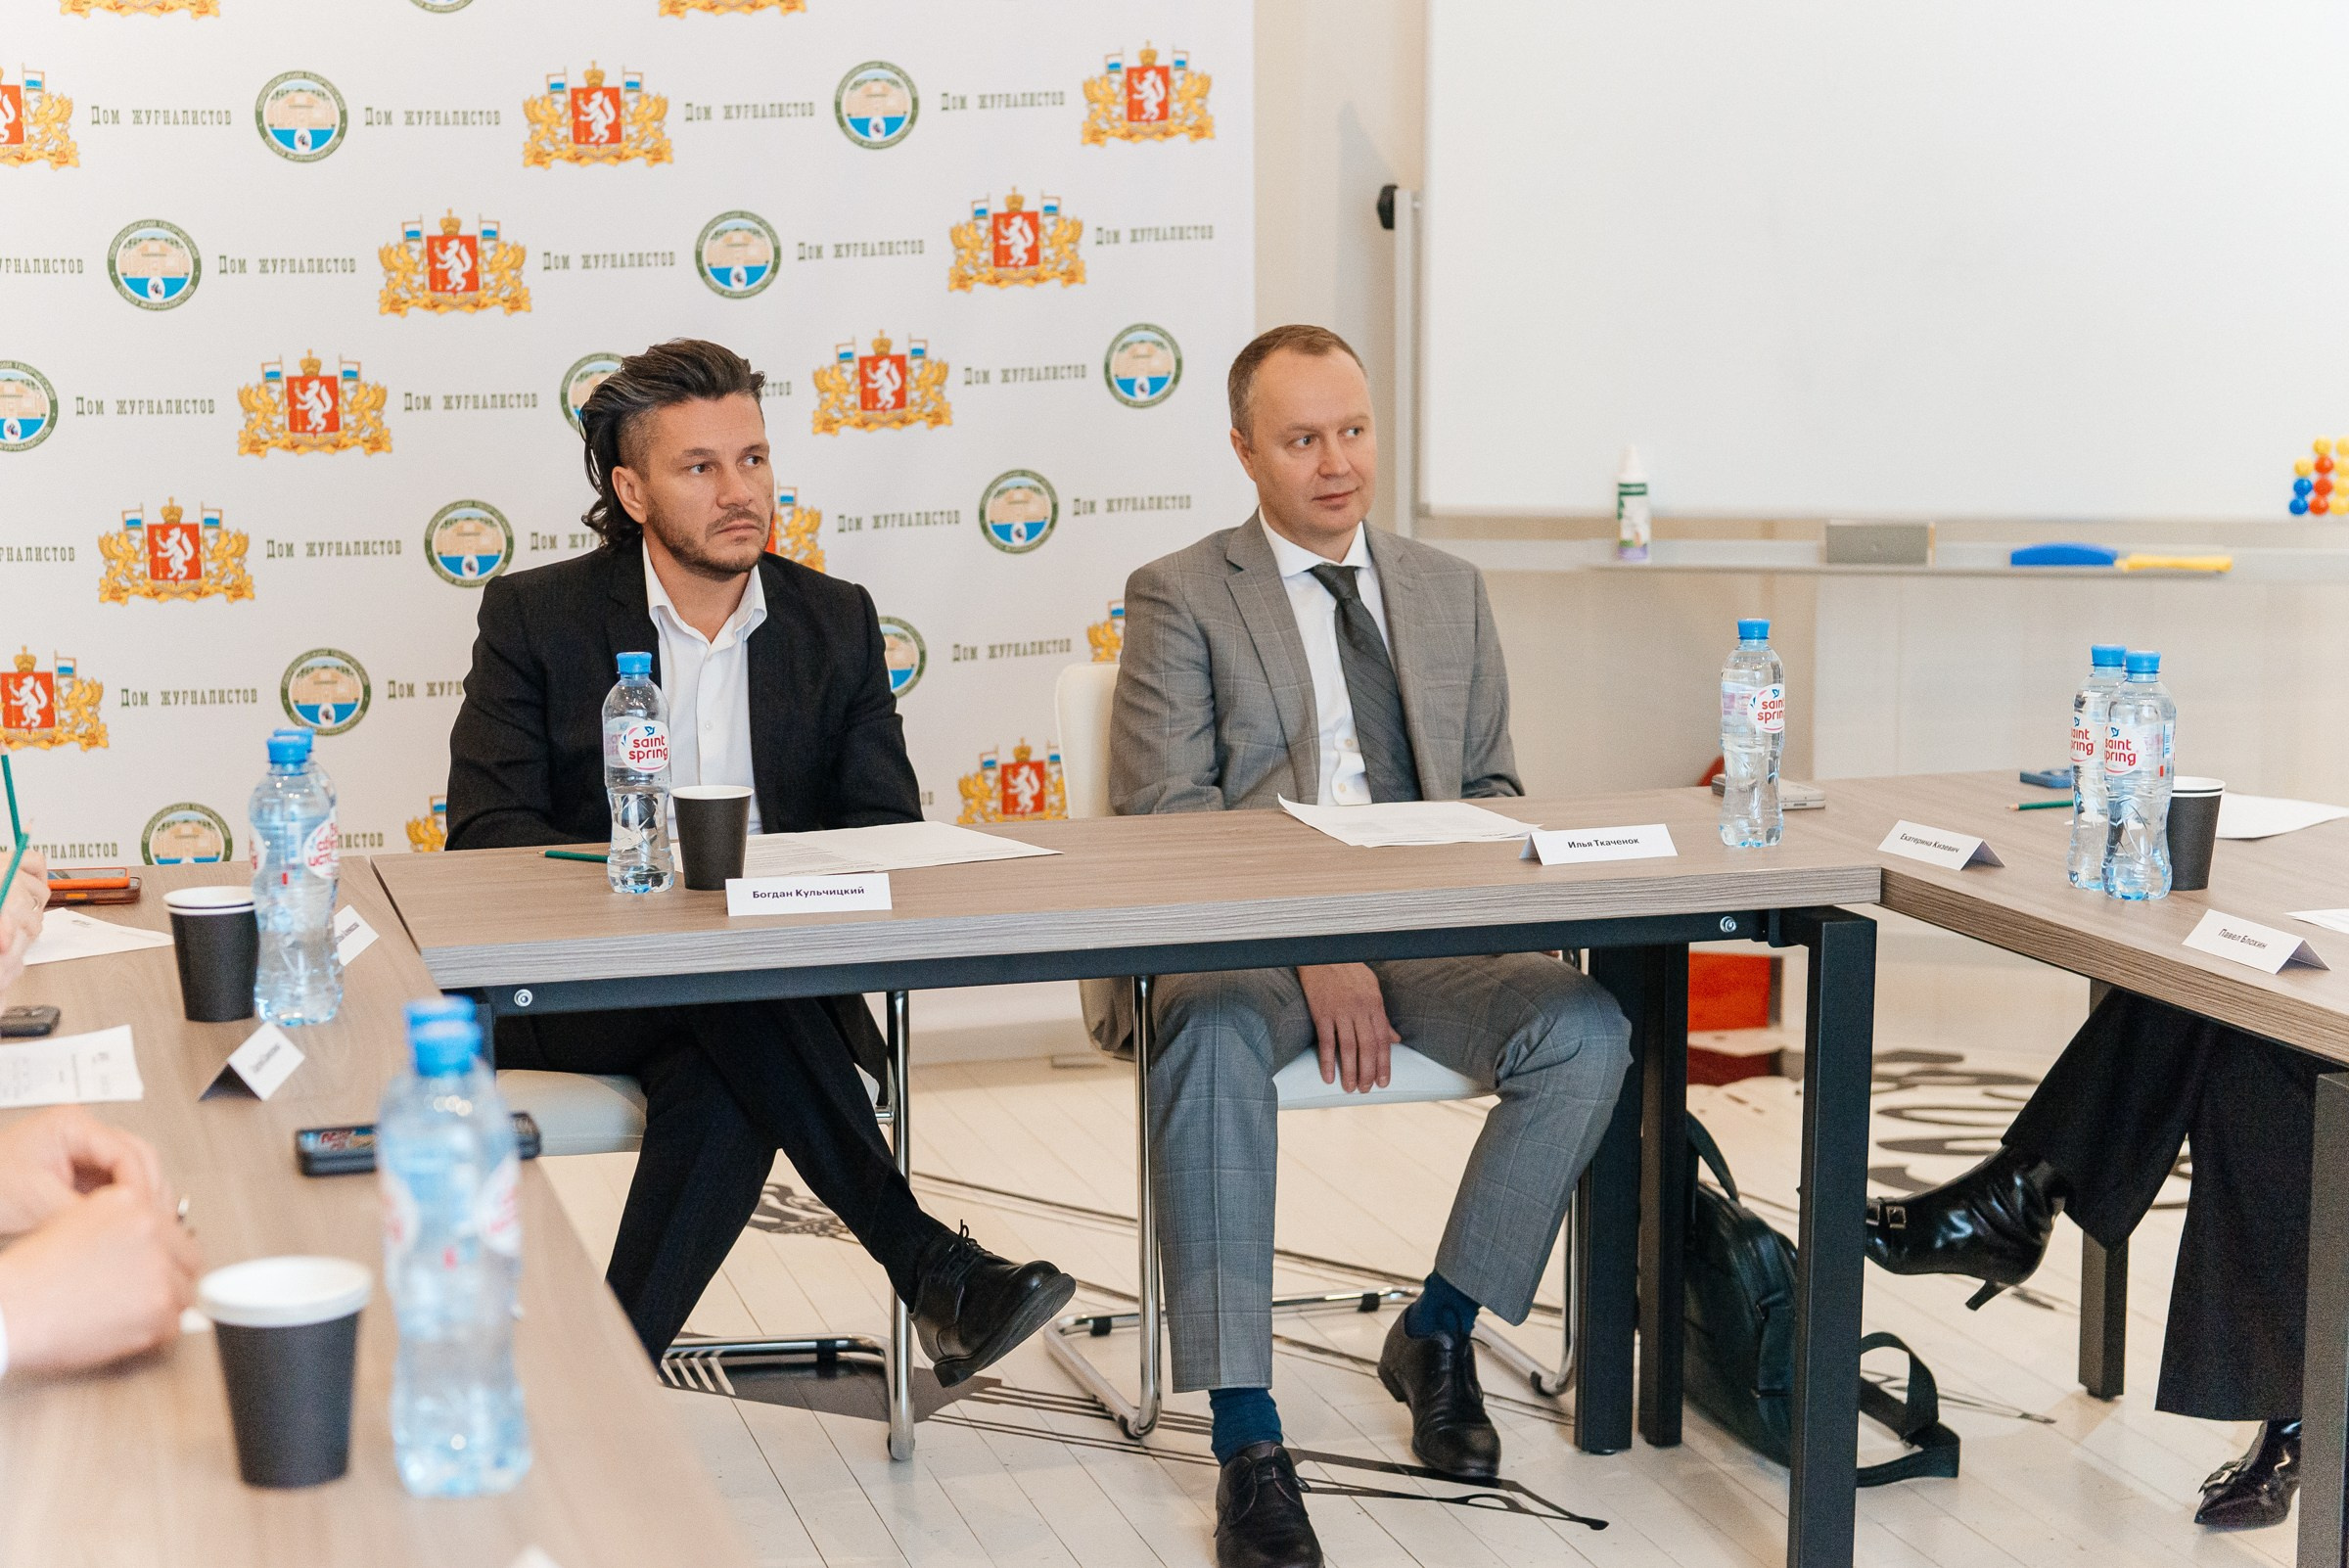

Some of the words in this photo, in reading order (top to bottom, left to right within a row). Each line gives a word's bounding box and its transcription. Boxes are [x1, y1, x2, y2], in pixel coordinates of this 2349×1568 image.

[1757, 710, 1785, 723] sprin
[2070, 728, 2090, 741] aint
[633, 735, 665, 749] saint
[628, 747, 668, 762] spring
[2104, 750, 2137, 766] pring
[1593, 838, 1639, 847] Ткаченок
[1900, 833, 1932, 846] Екатерина
[753, 890, 793, 899] Богдан
[795, 886, 865, 899] Кульчицкий
[2218, 928, 2241, 941] Павел
[2240, 935, 2268, 949] Блохин
